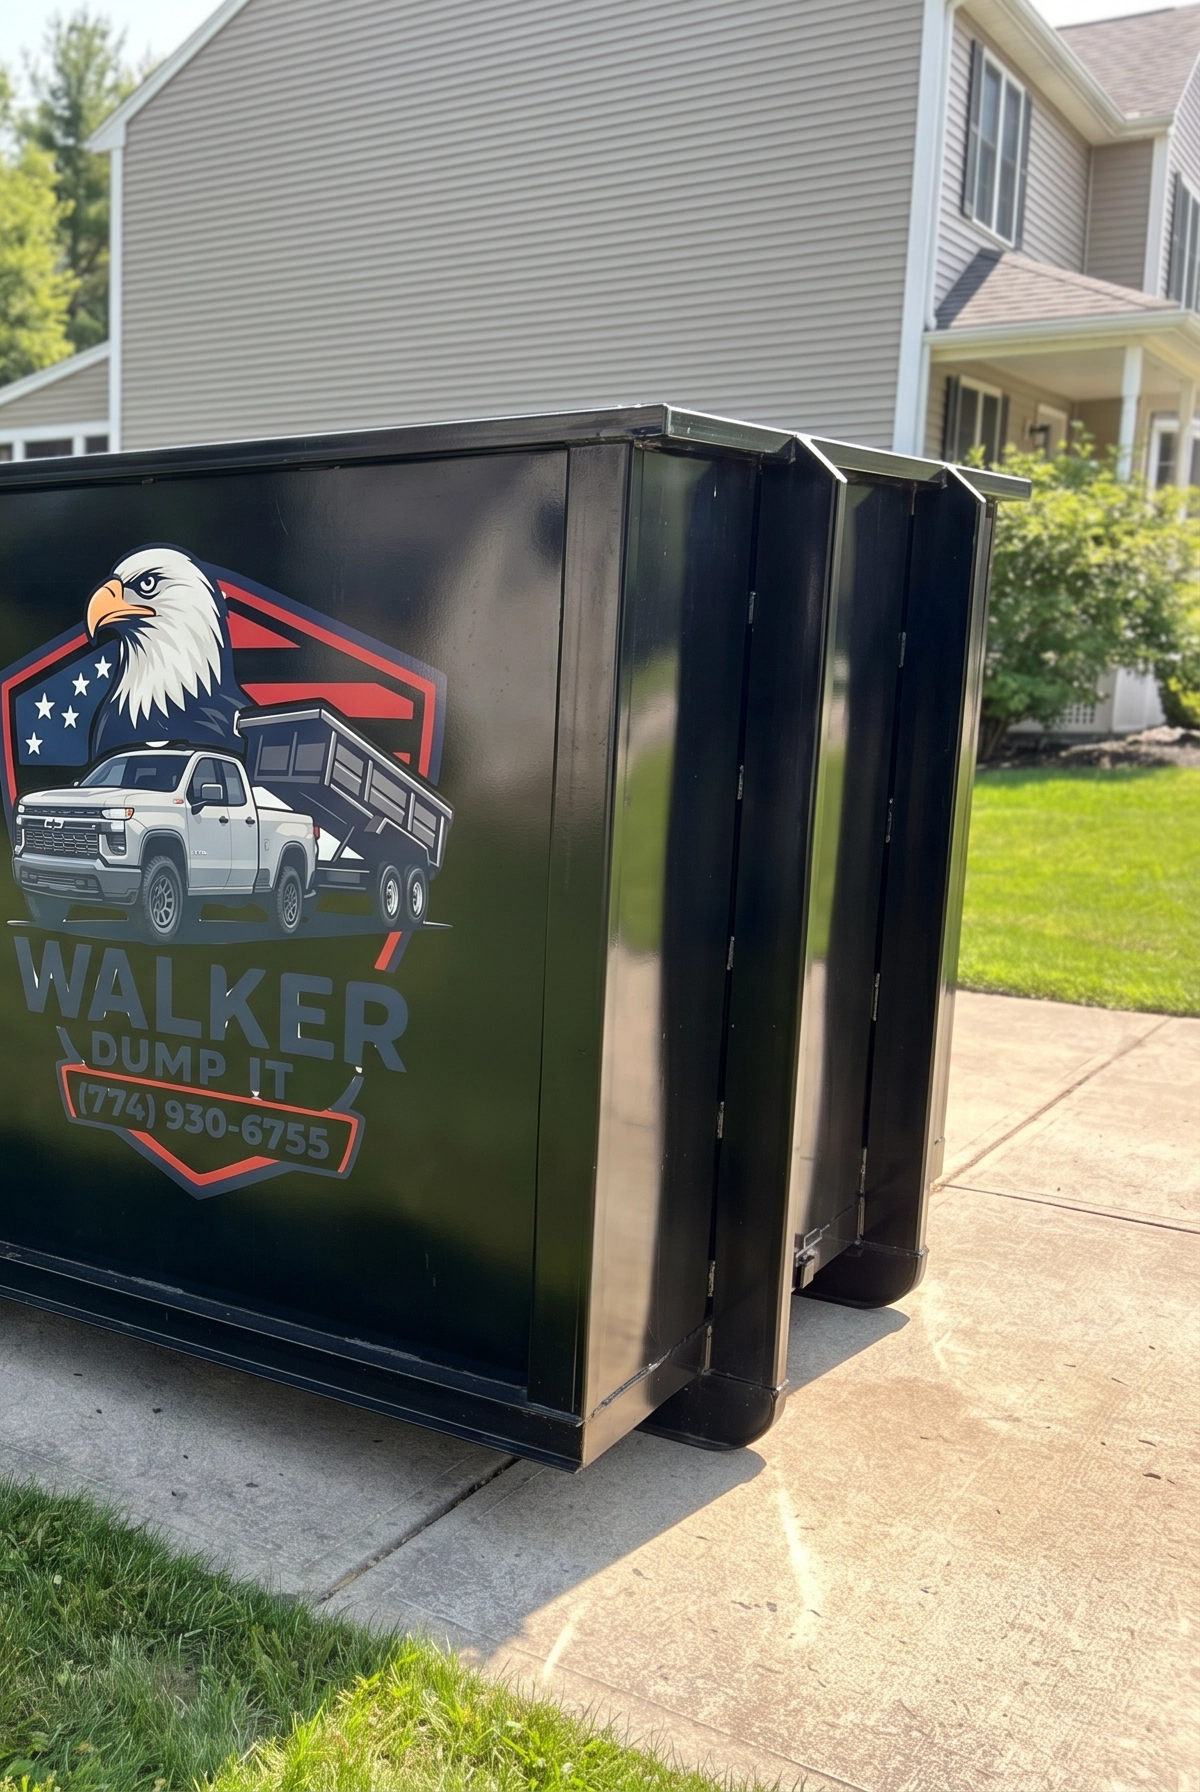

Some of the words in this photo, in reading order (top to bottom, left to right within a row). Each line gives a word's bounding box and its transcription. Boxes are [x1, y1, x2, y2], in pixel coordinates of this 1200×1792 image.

[13, 936, 409, 1073] WALKER
[91, 1031, 226, 1085] DUMP
[249, 1057, 294, 1099] IT
[78, 1081, 155, 1129] (774)
[166, 1105, 330, 1159] 930-6755
